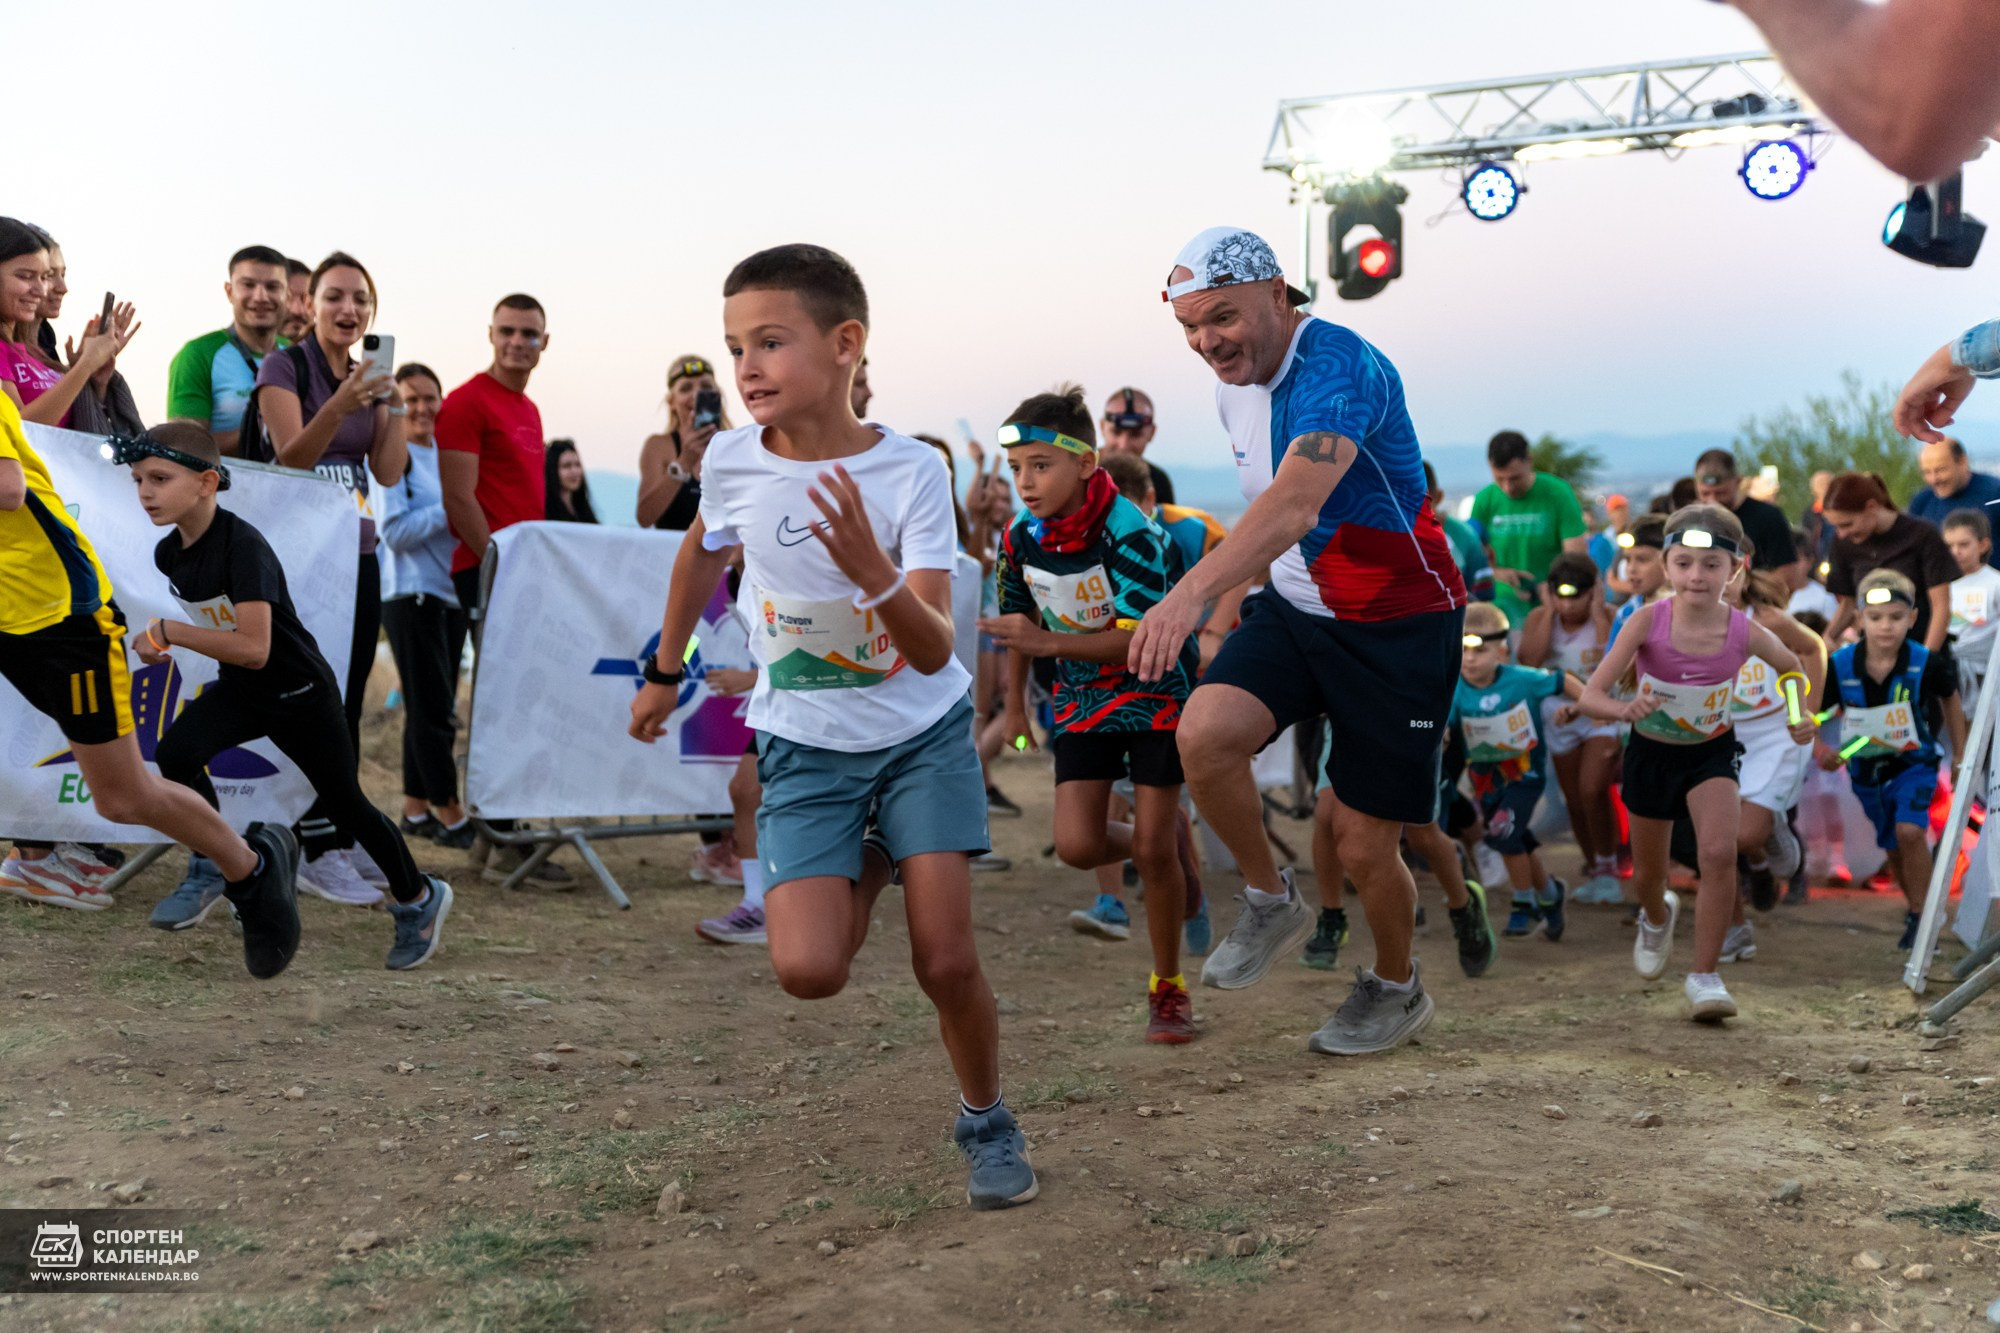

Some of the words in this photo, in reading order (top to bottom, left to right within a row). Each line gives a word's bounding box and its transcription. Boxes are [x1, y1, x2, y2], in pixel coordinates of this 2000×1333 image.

[1075, 575, 1106, 603] 49
[200, 603, 236, 627] 74
[1076, 603, 1110, 622] KIDS
[855, 633, 894, 661] KID
[1740, 663, 1765, 684] 50
[1704, 687, 1729, 710] 47
[1410, 719, 1434, 728] BOSS
[1507, 709, 1528, 733] 80
[1694, 710, 1724, 726] KIDS
[1884, 708, 1908, 727] 48
[58, 774, 92, 803] EC
[240, 783, 256, 798] day
